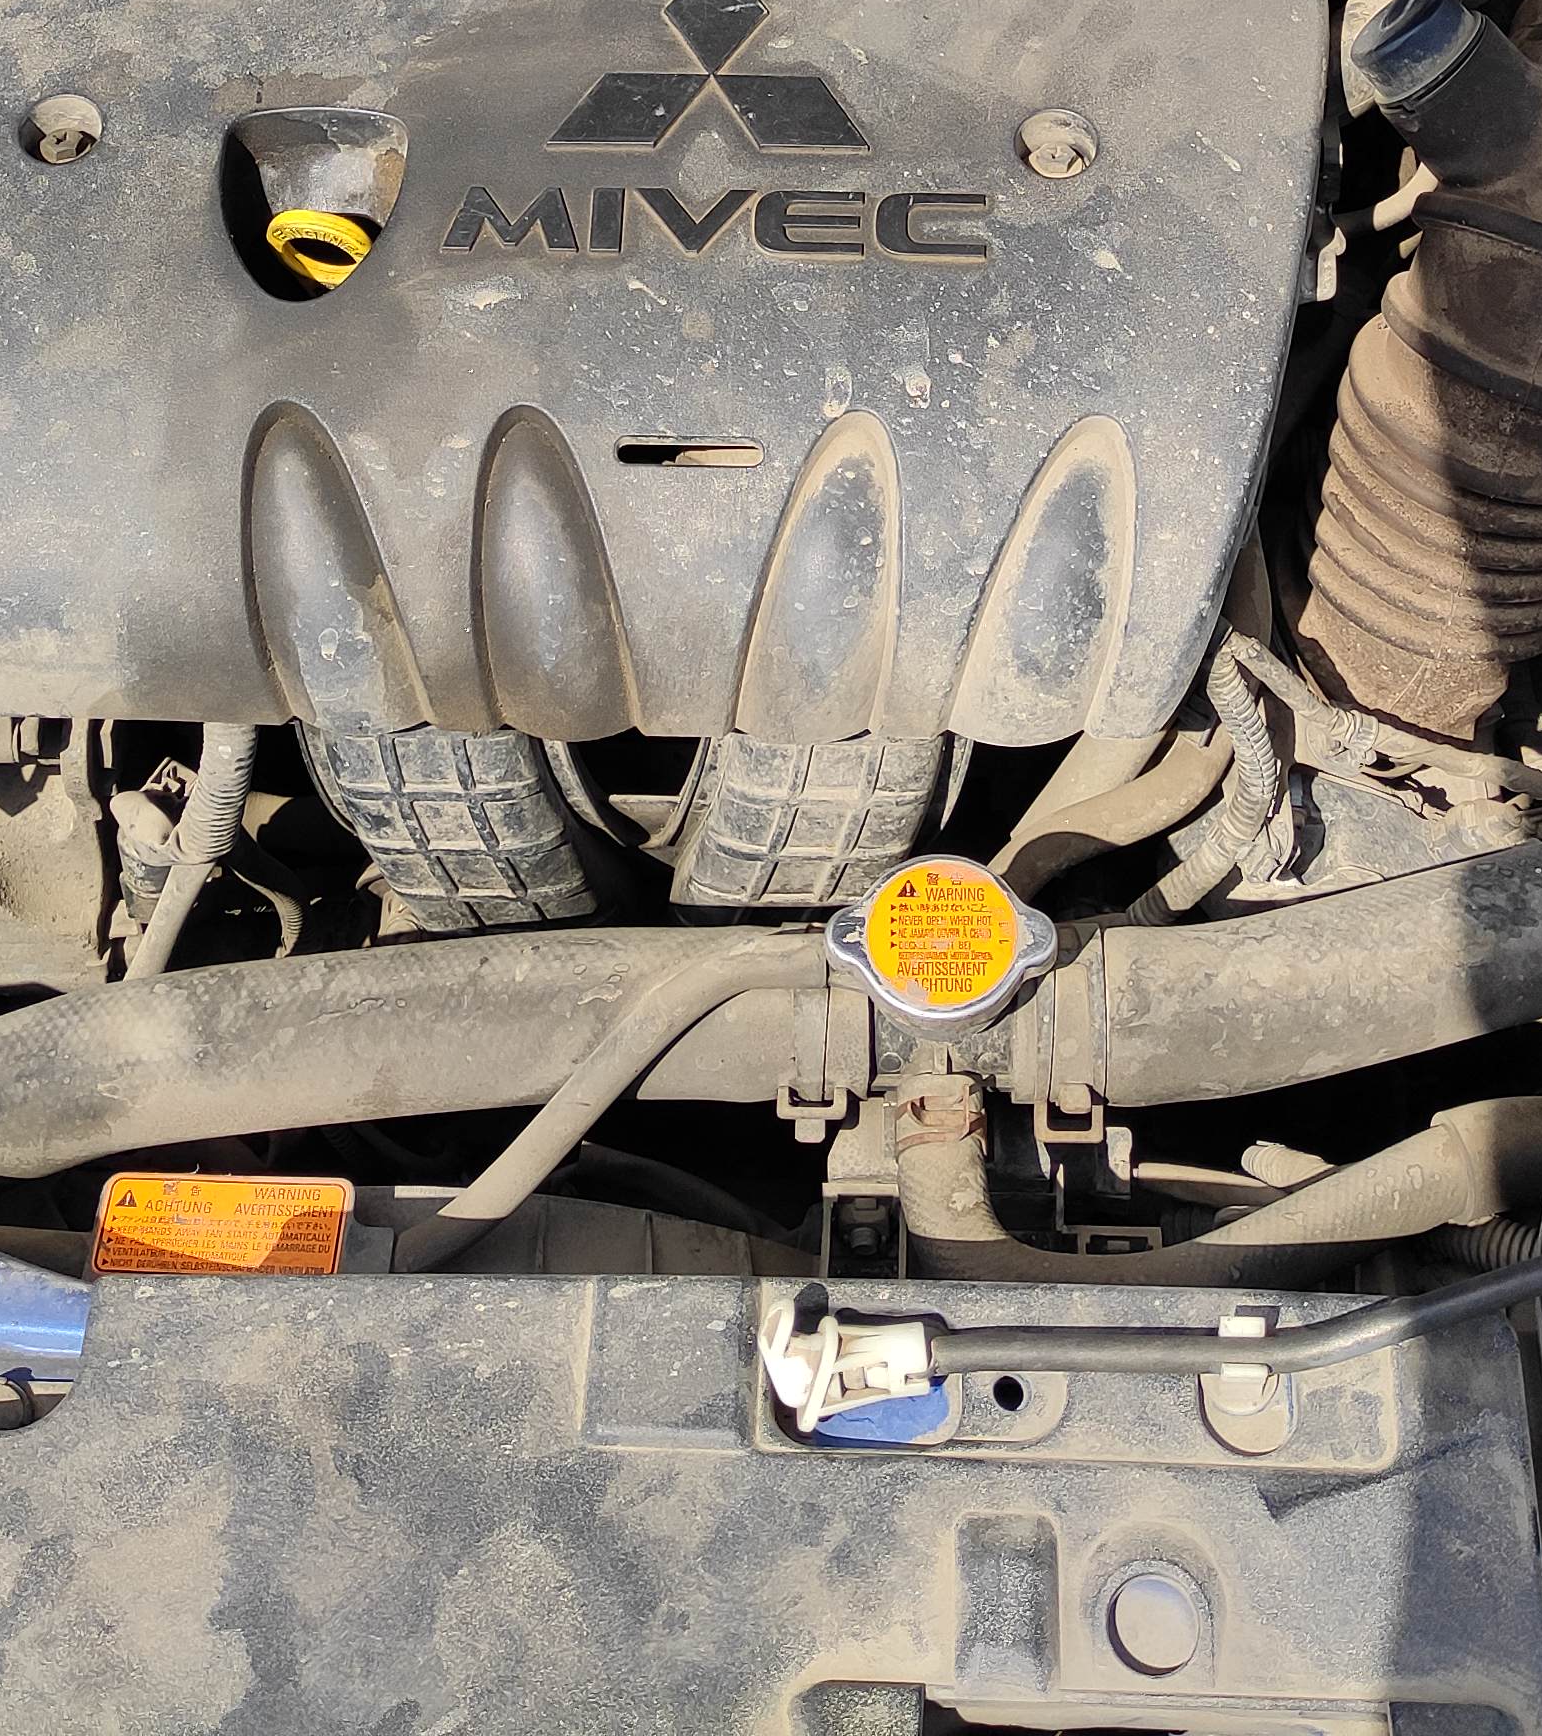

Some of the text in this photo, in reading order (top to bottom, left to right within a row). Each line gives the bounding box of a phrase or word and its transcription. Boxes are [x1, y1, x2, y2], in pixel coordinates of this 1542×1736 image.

[440, 185, 989, 260] MIVEC
[925, 887, 985, 902] WARNING
[899, 915, 923, 926] NEVER
[949, 915, 974, 926] WHEN
[897, 962, 987, 976] AVERTISSEMENT
[254, 1187, 321, 1201] WARNING
[145, 1200, 213, 1215] ACHTUNG
[234, 1203, 336, 1218] AVERTISSEMENT
[318, 1244, 331, 1253] DU
